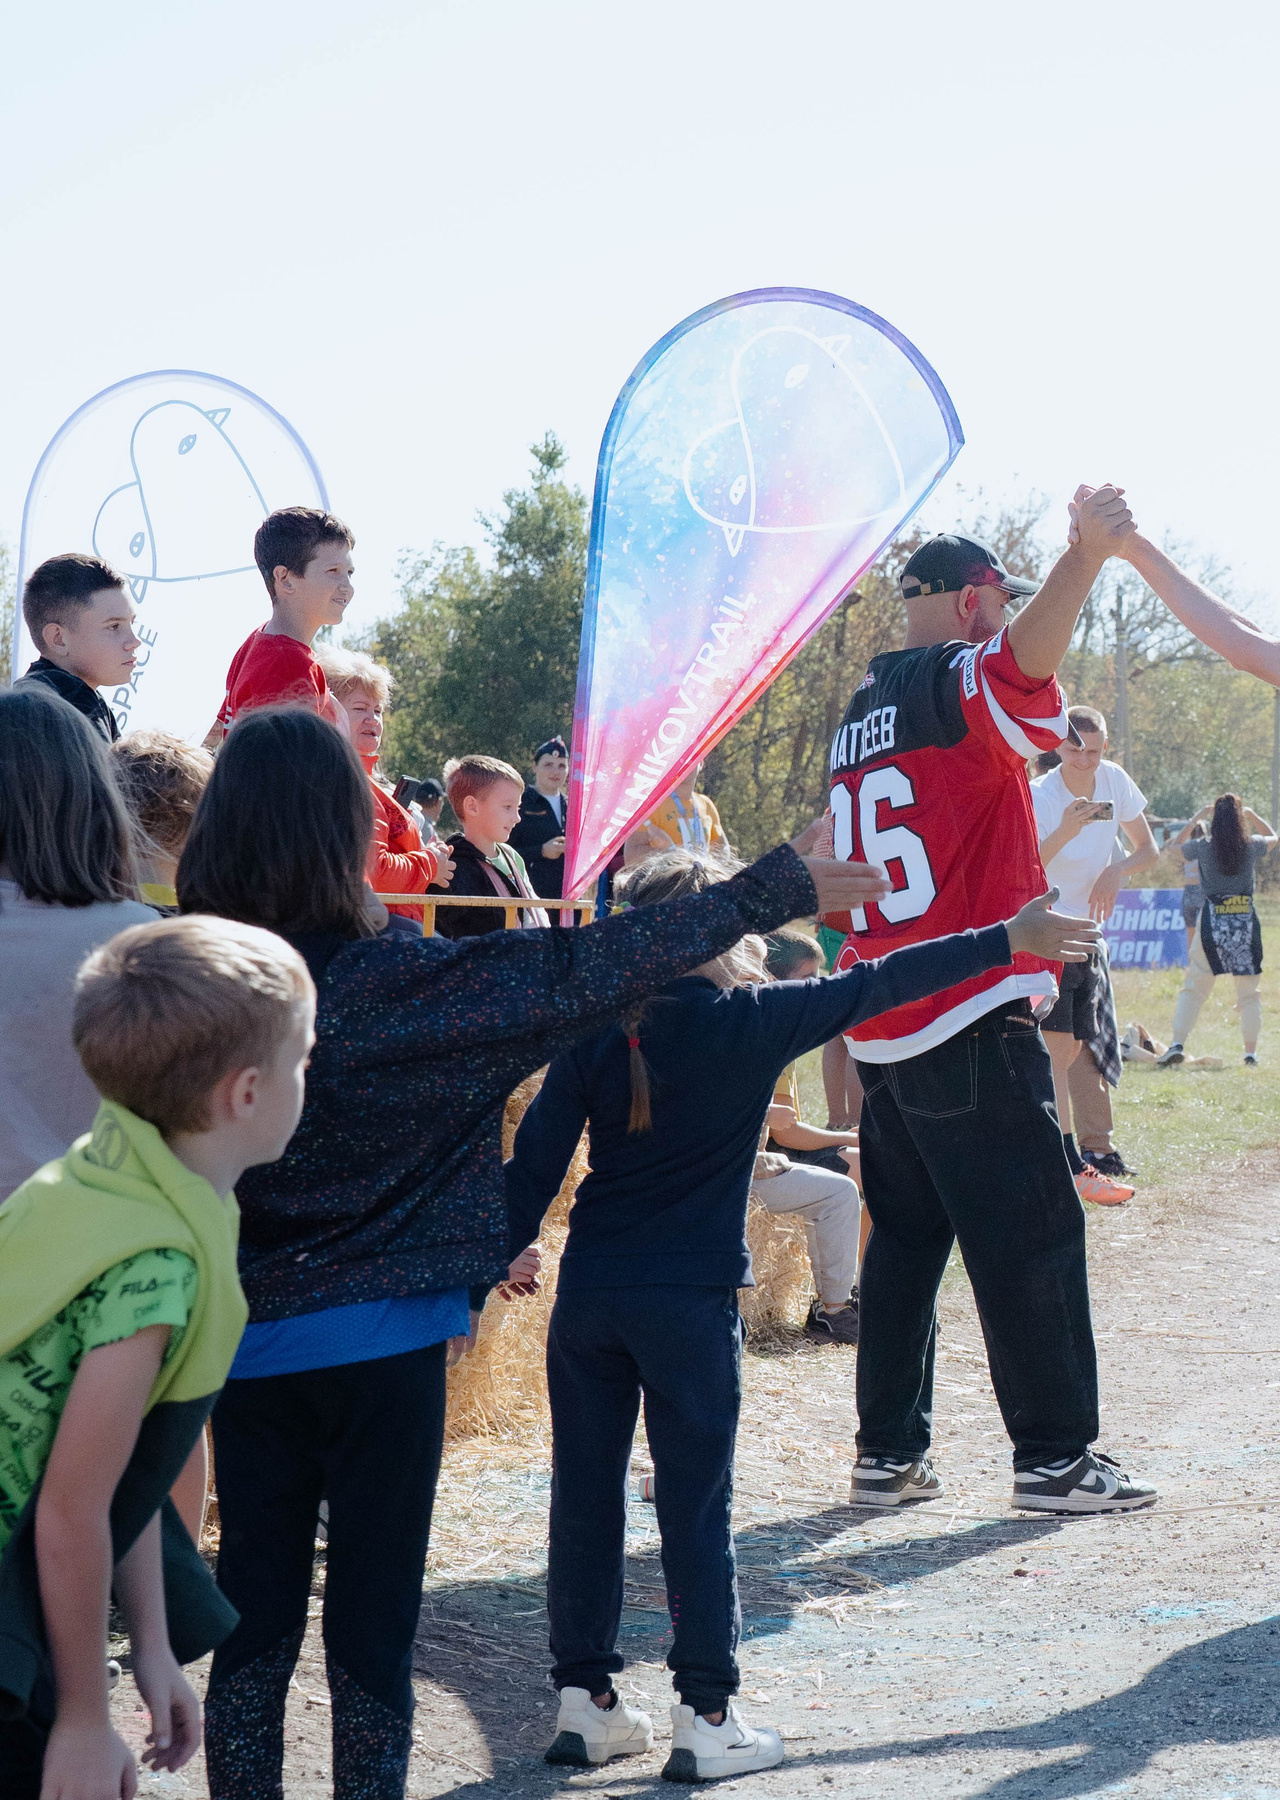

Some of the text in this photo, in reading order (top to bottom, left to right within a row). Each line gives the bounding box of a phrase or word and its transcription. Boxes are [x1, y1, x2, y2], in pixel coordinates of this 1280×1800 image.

[113, 625, 158, 731] SPACE
[1105, 905, 1185, 932] бнись
[119, 1278, 158, 1297] FILA
[860, 1457, 877, 1466] NIKE
